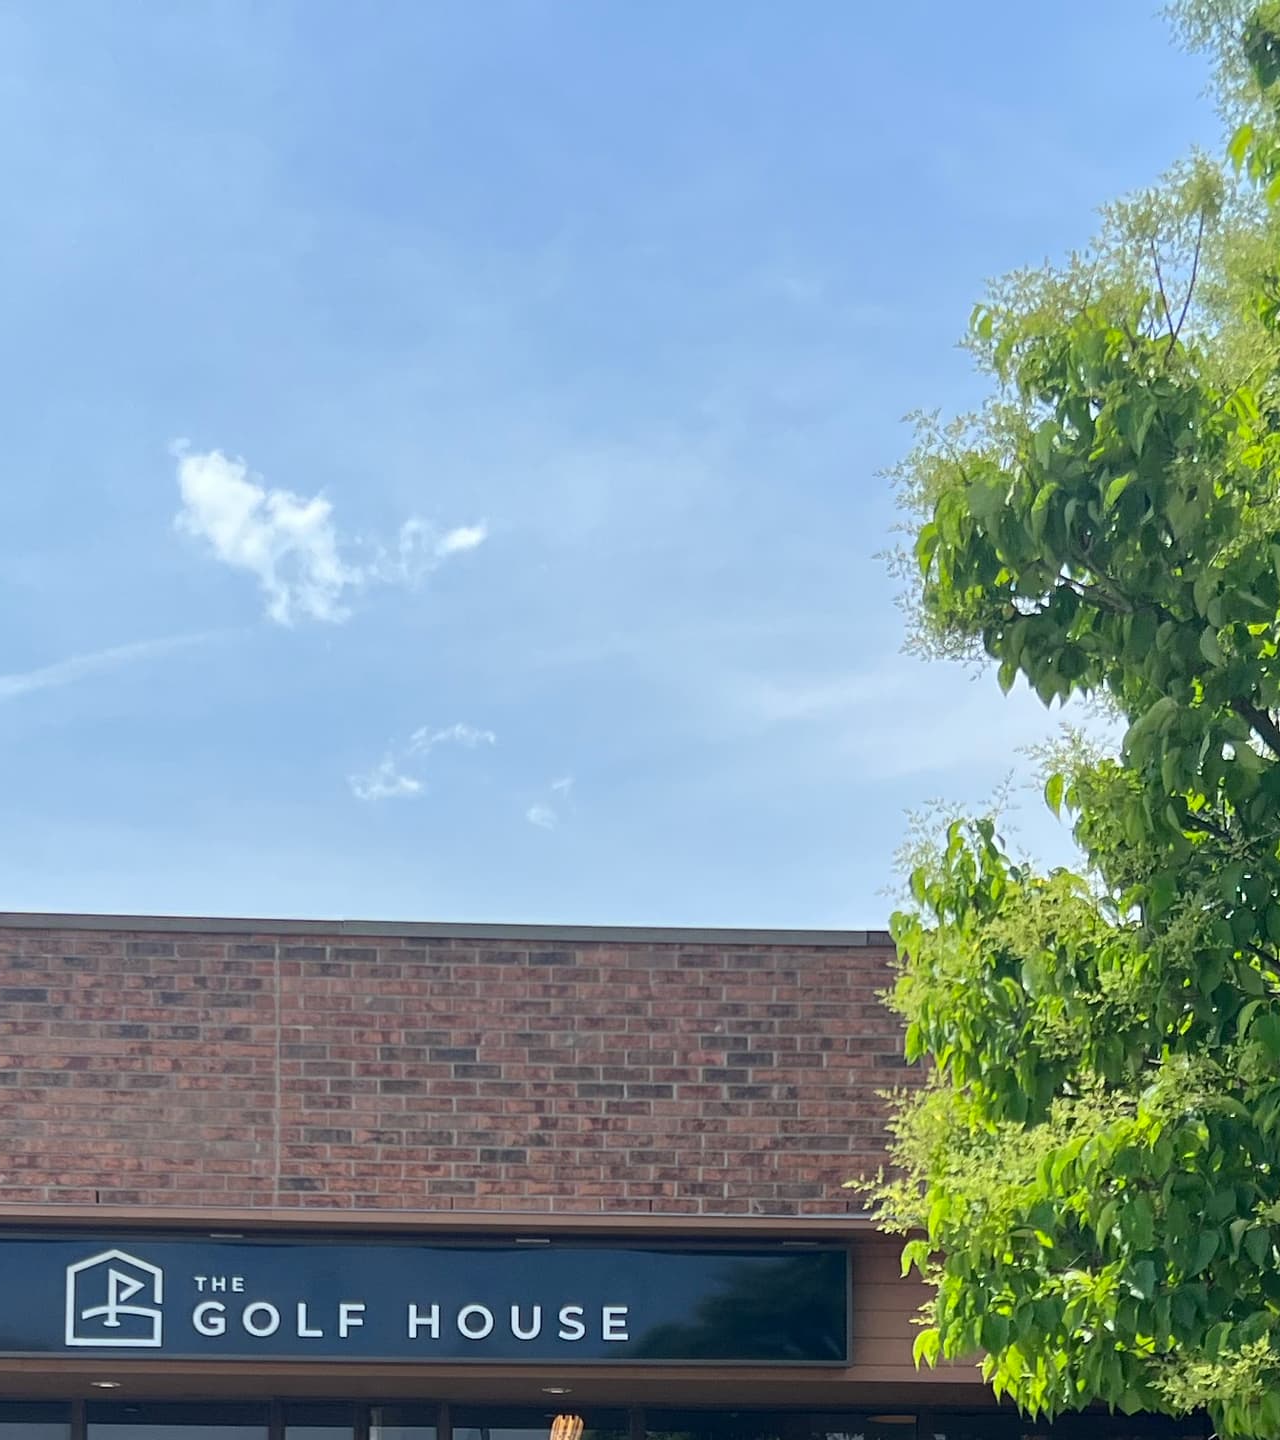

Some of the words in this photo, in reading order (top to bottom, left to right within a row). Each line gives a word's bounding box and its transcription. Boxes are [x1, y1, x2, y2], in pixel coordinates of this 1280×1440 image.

[195, 1276, 245, 1293] THE
[192, 1302, 367, 1339] GOLF
[408, 1304, 632, 1341] HOUSE
